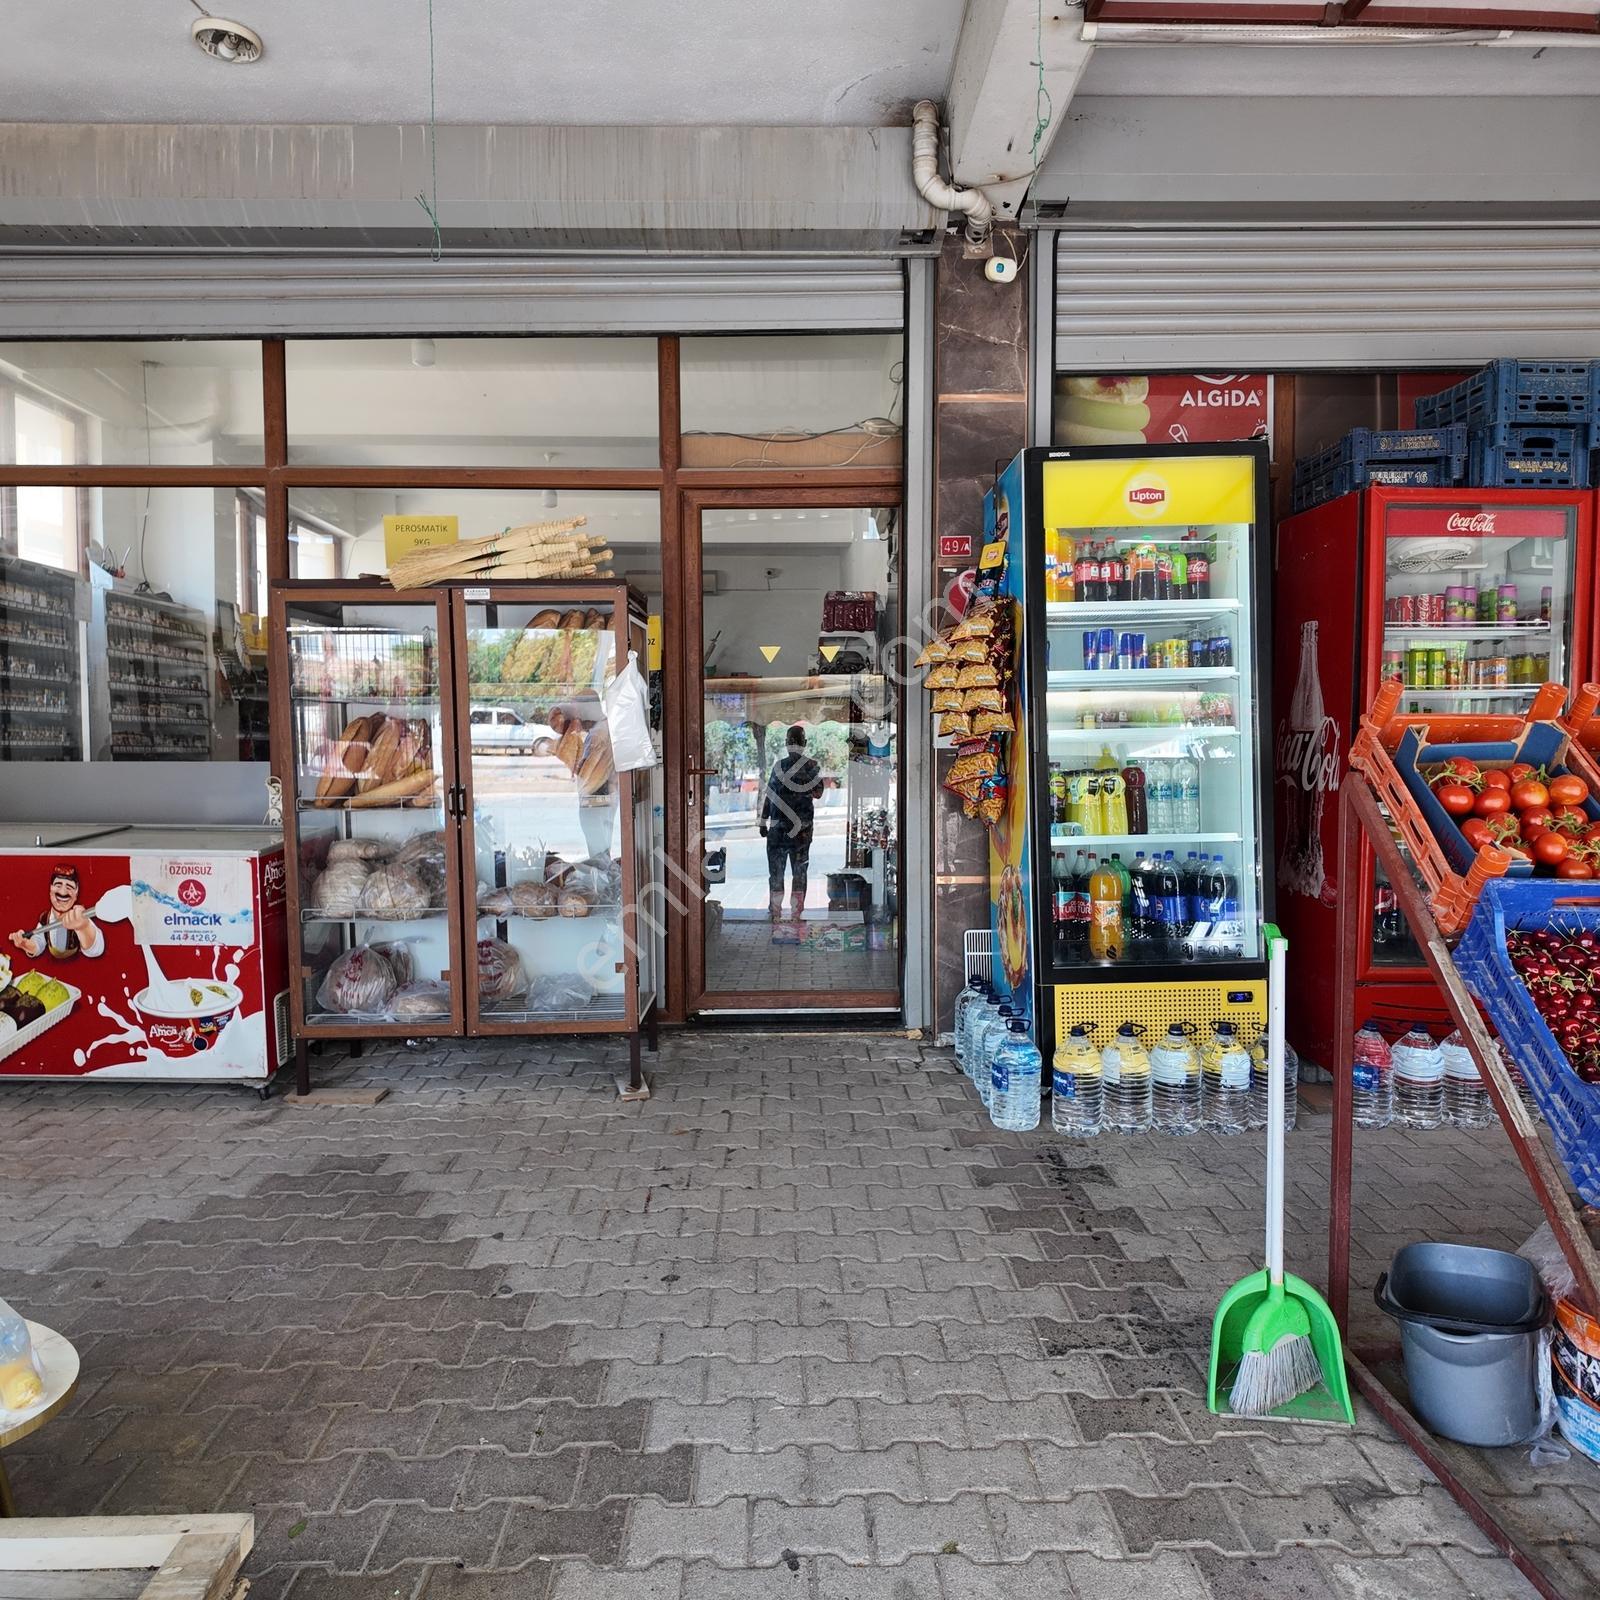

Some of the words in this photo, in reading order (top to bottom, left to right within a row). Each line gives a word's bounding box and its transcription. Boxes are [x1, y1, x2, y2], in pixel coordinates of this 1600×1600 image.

[1131, 491, 1163, 503] Lipton
[1447, 512, 1496, 533] Coca-Cola
[169, 866, 212, 876] OZONSUZ
